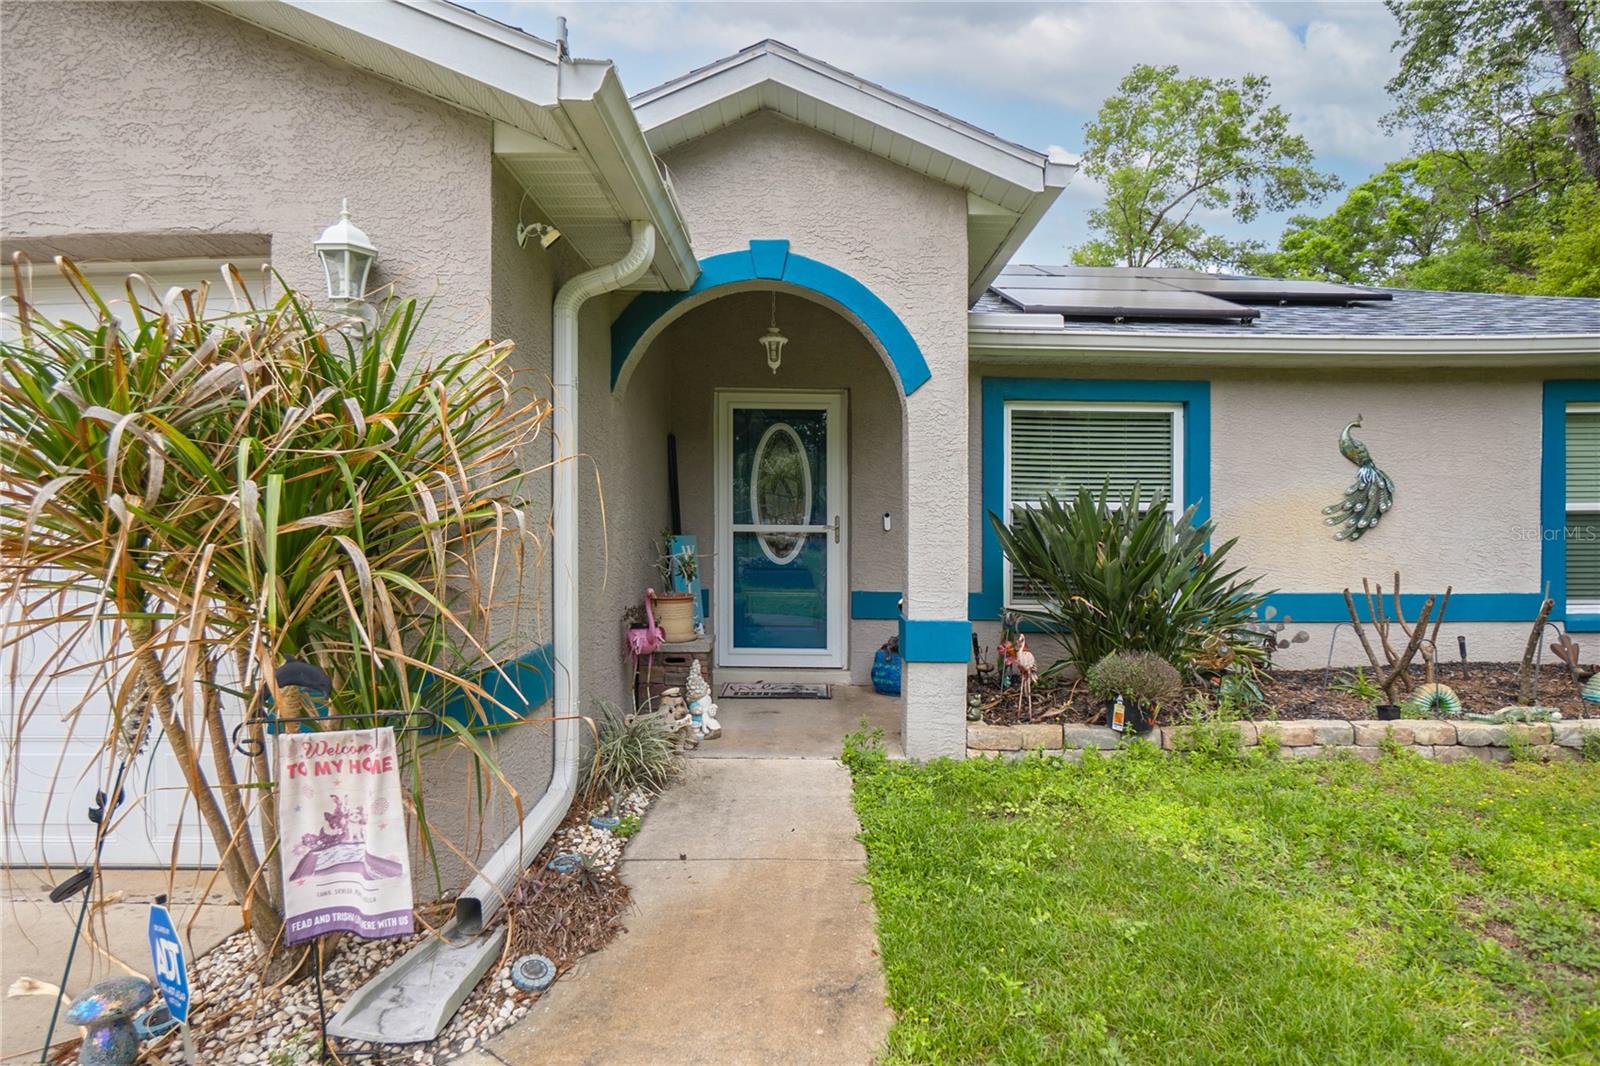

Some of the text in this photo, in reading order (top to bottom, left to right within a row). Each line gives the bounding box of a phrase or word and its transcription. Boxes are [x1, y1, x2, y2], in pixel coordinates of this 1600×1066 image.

[287, 761, 307, 779] TO
[314, 760, 343, 777] MY
[314, 913, 331, 926] AND
[377, 916, 397, 929] WITH
[398, 915, 409, 926] US
[155, 937, 181, 985] ADT
